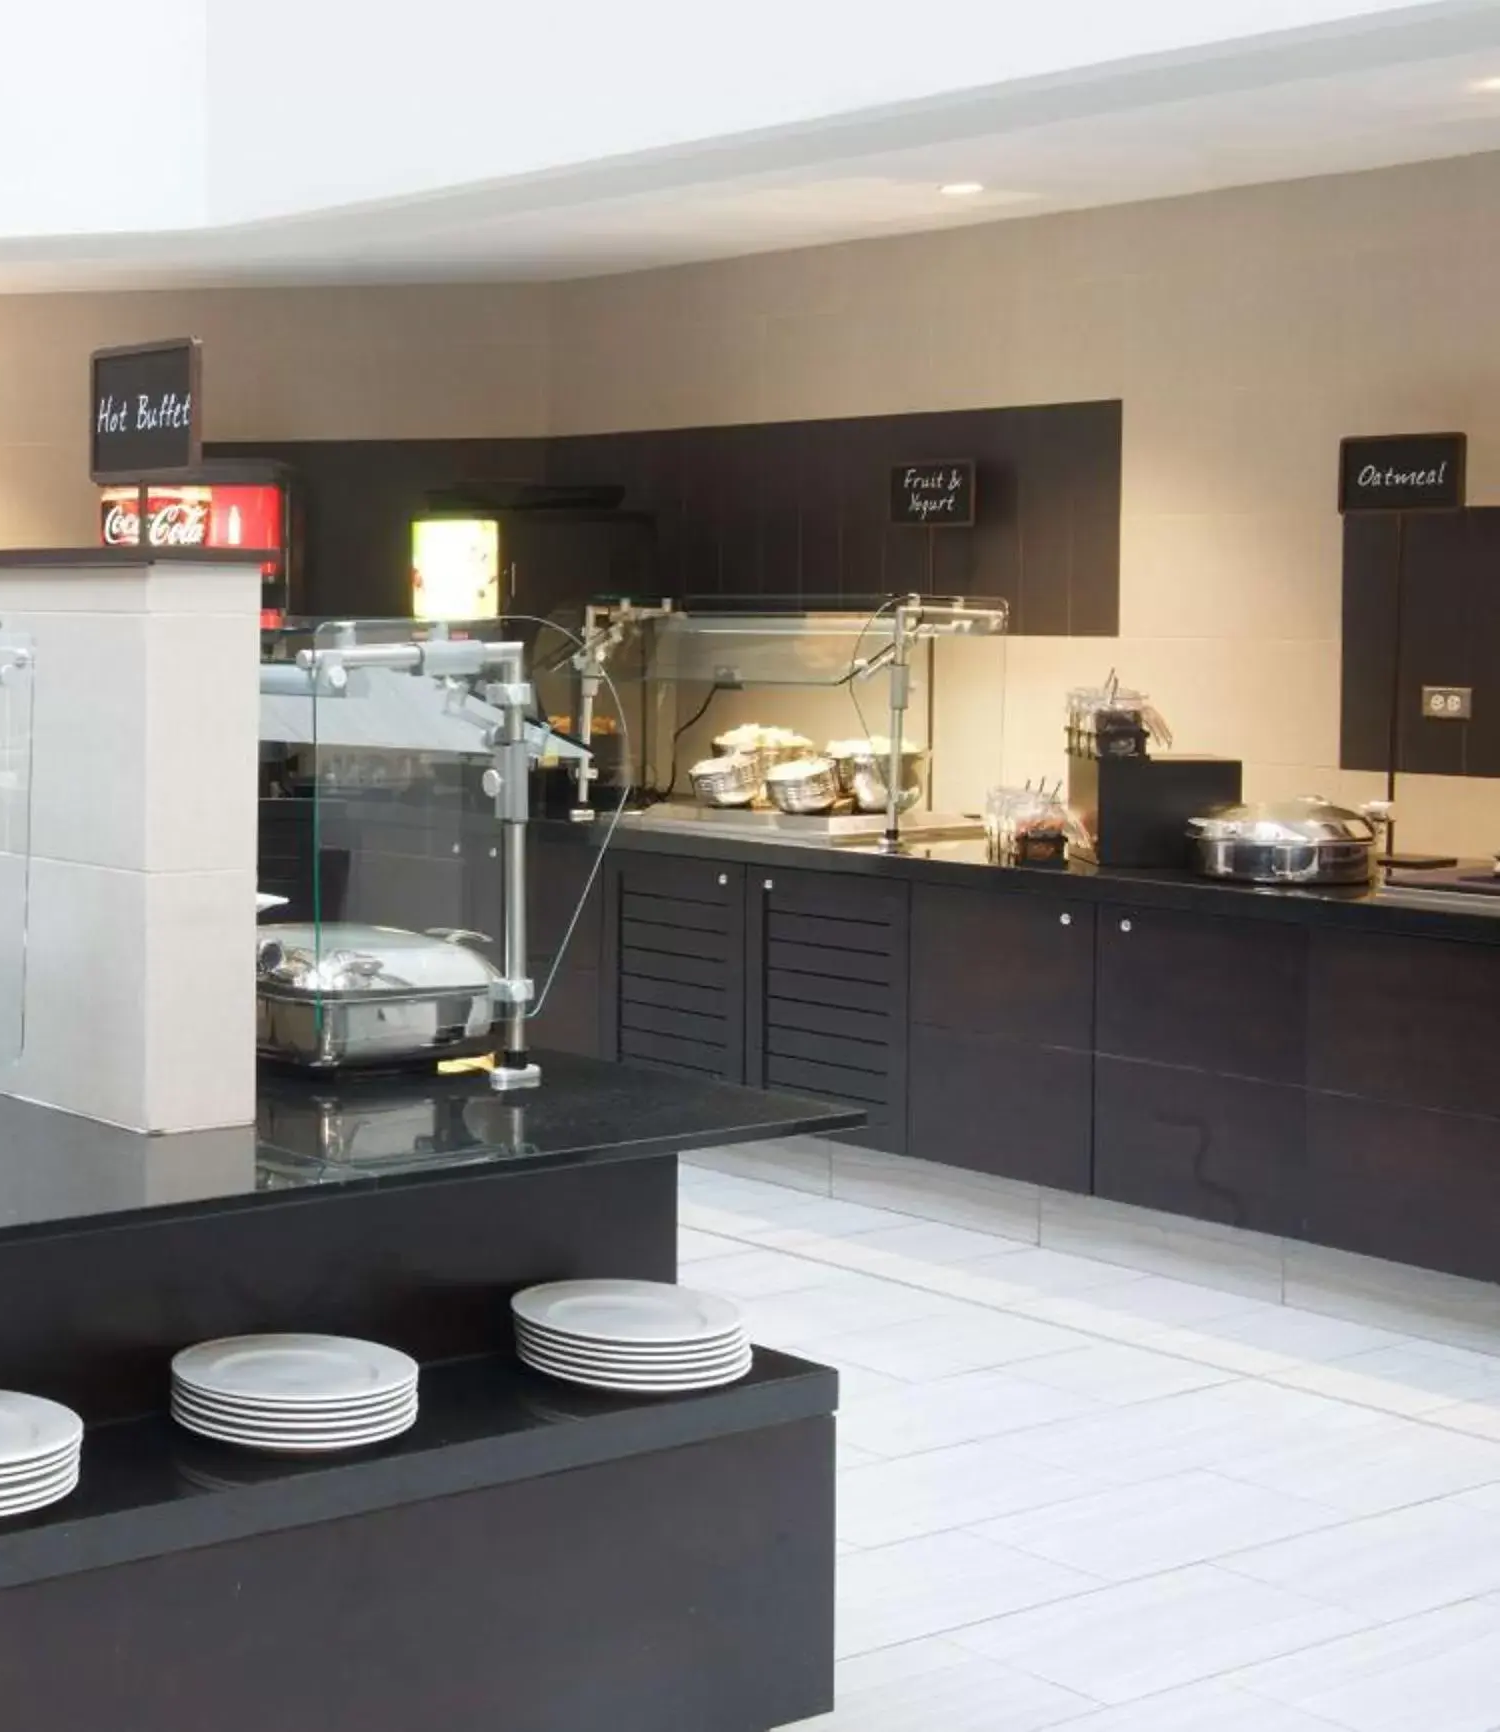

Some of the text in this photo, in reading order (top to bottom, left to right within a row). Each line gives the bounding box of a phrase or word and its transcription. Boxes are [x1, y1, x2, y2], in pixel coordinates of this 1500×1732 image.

[97, 391, 192, 433] Hot Buffet
[903, 467, 962, 491] Fruit &
[1356, 460, 1448, 487] Oatmeal
[907, 491, 956, 521] Yogurt
